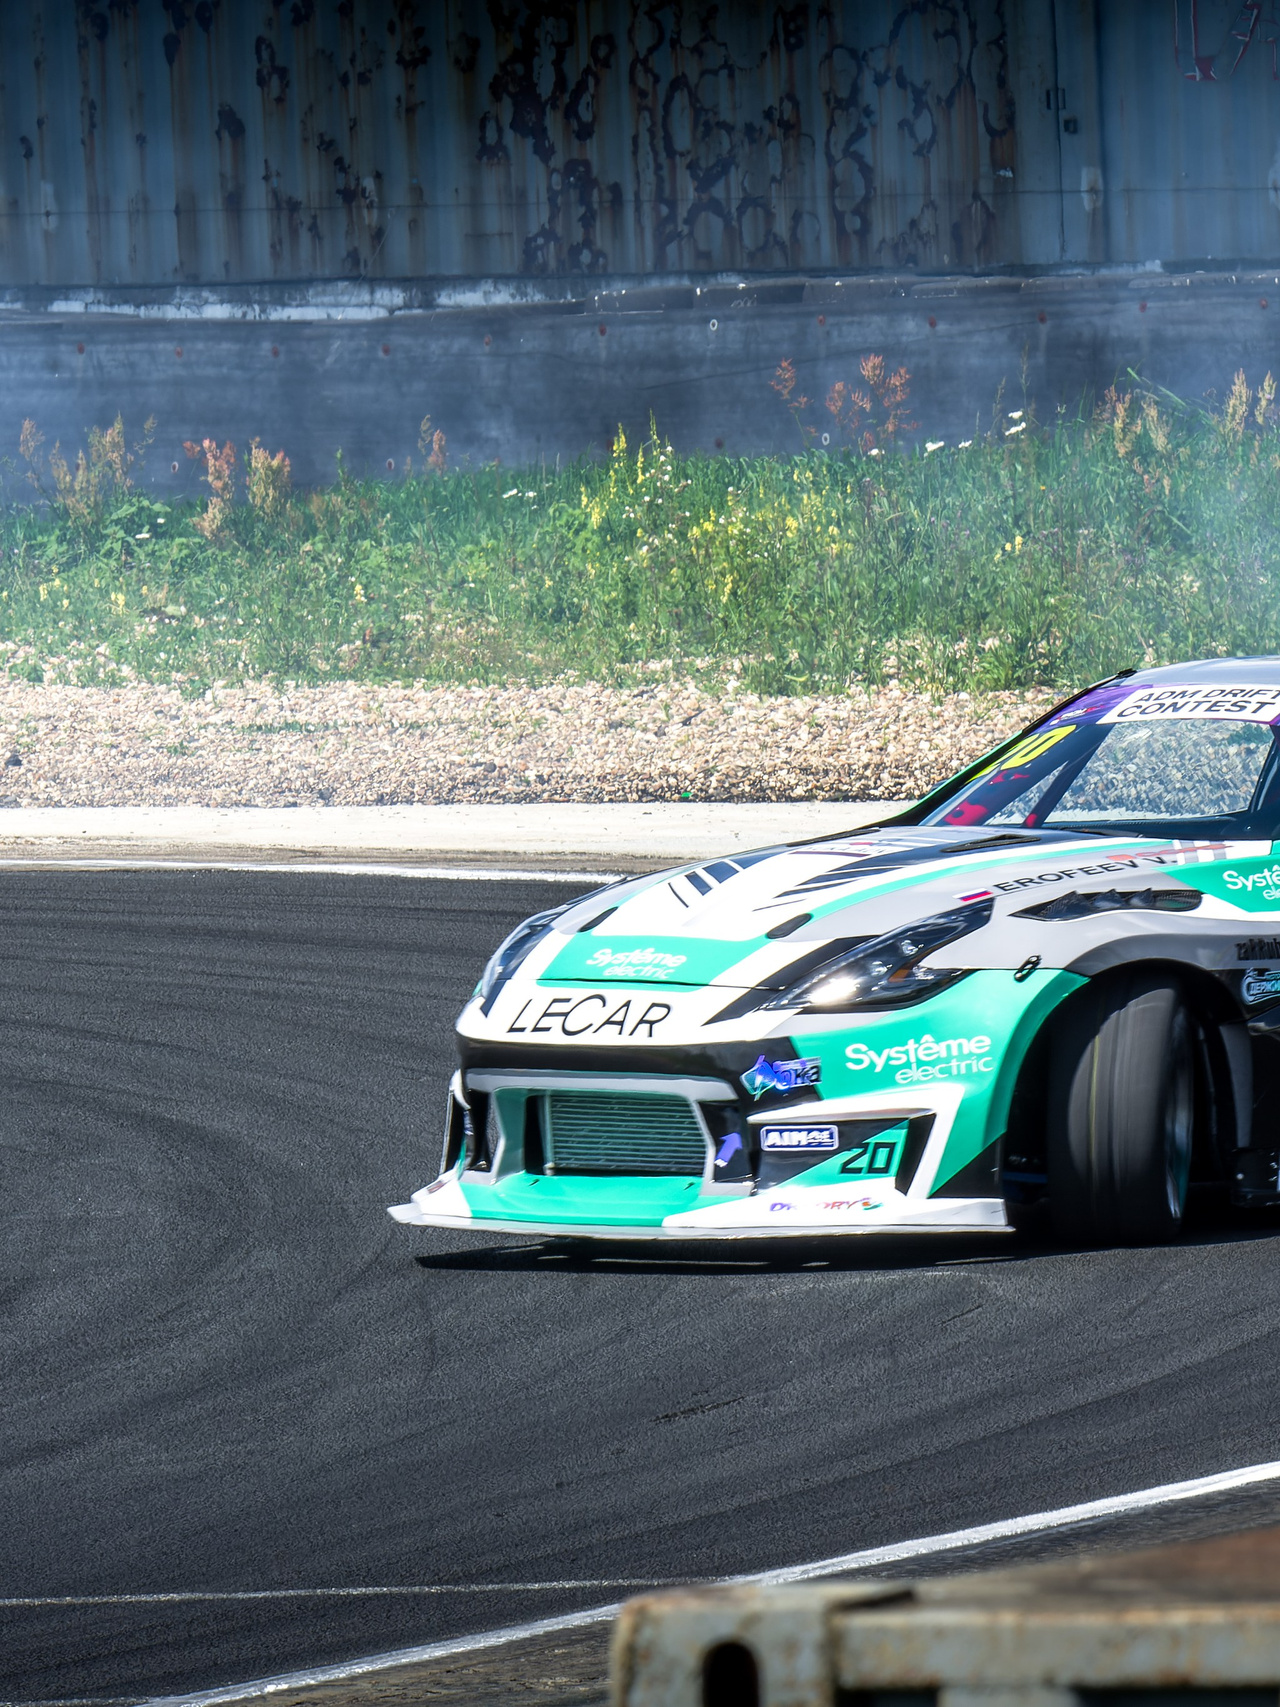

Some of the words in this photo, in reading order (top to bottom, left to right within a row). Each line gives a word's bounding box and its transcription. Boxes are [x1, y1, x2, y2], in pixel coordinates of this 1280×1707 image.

[1117, 700, 1277, 718] CONTEST
[1133, 689, 1203, 704] ADM
[993, 859, 1139, 892] EROFEEV
[602, 965, 675, 979] electric
[506, 994, 672, 1038] LECAR
[845, 1034, 992, 1073] Système
[894, 1056, 994, 1084] electric
[840, 1142, 897, 1174] 20
